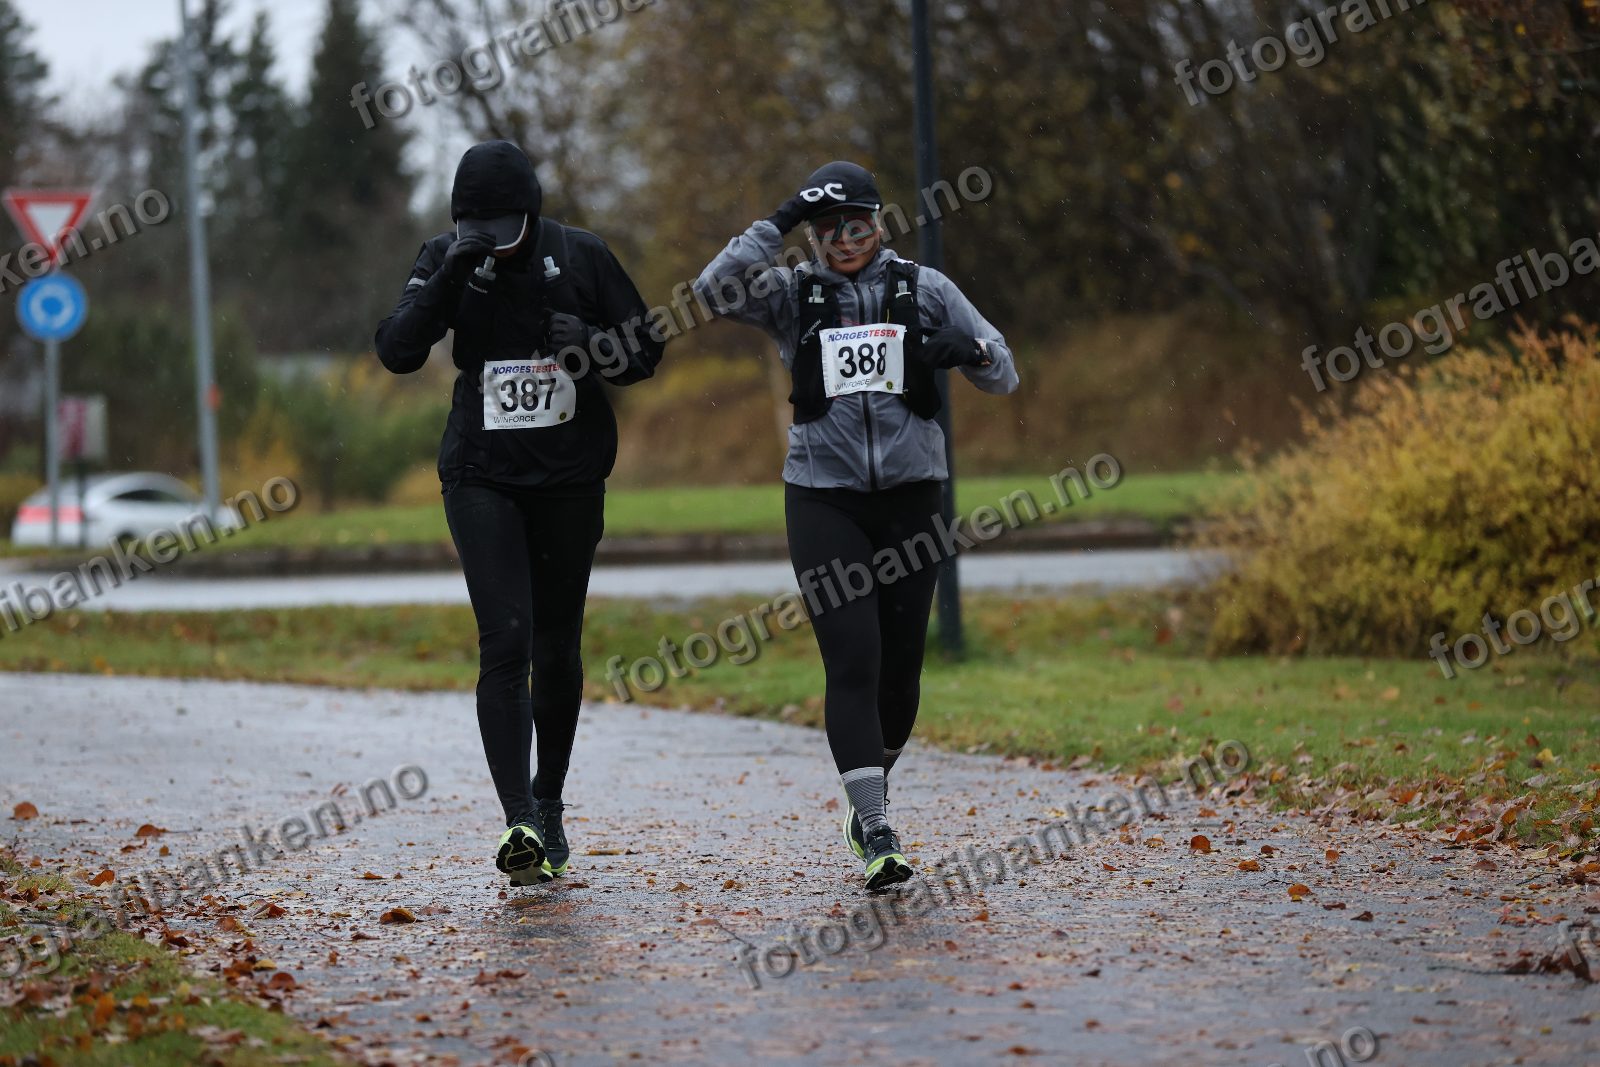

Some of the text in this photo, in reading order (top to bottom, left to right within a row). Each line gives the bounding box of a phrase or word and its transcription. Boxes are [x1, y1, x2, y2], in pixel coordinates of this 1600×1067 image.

[838, 342, 887, 379] 388
[500, 377, 557, 412] 387
[493, 415, 536, 424] WINFORCE
